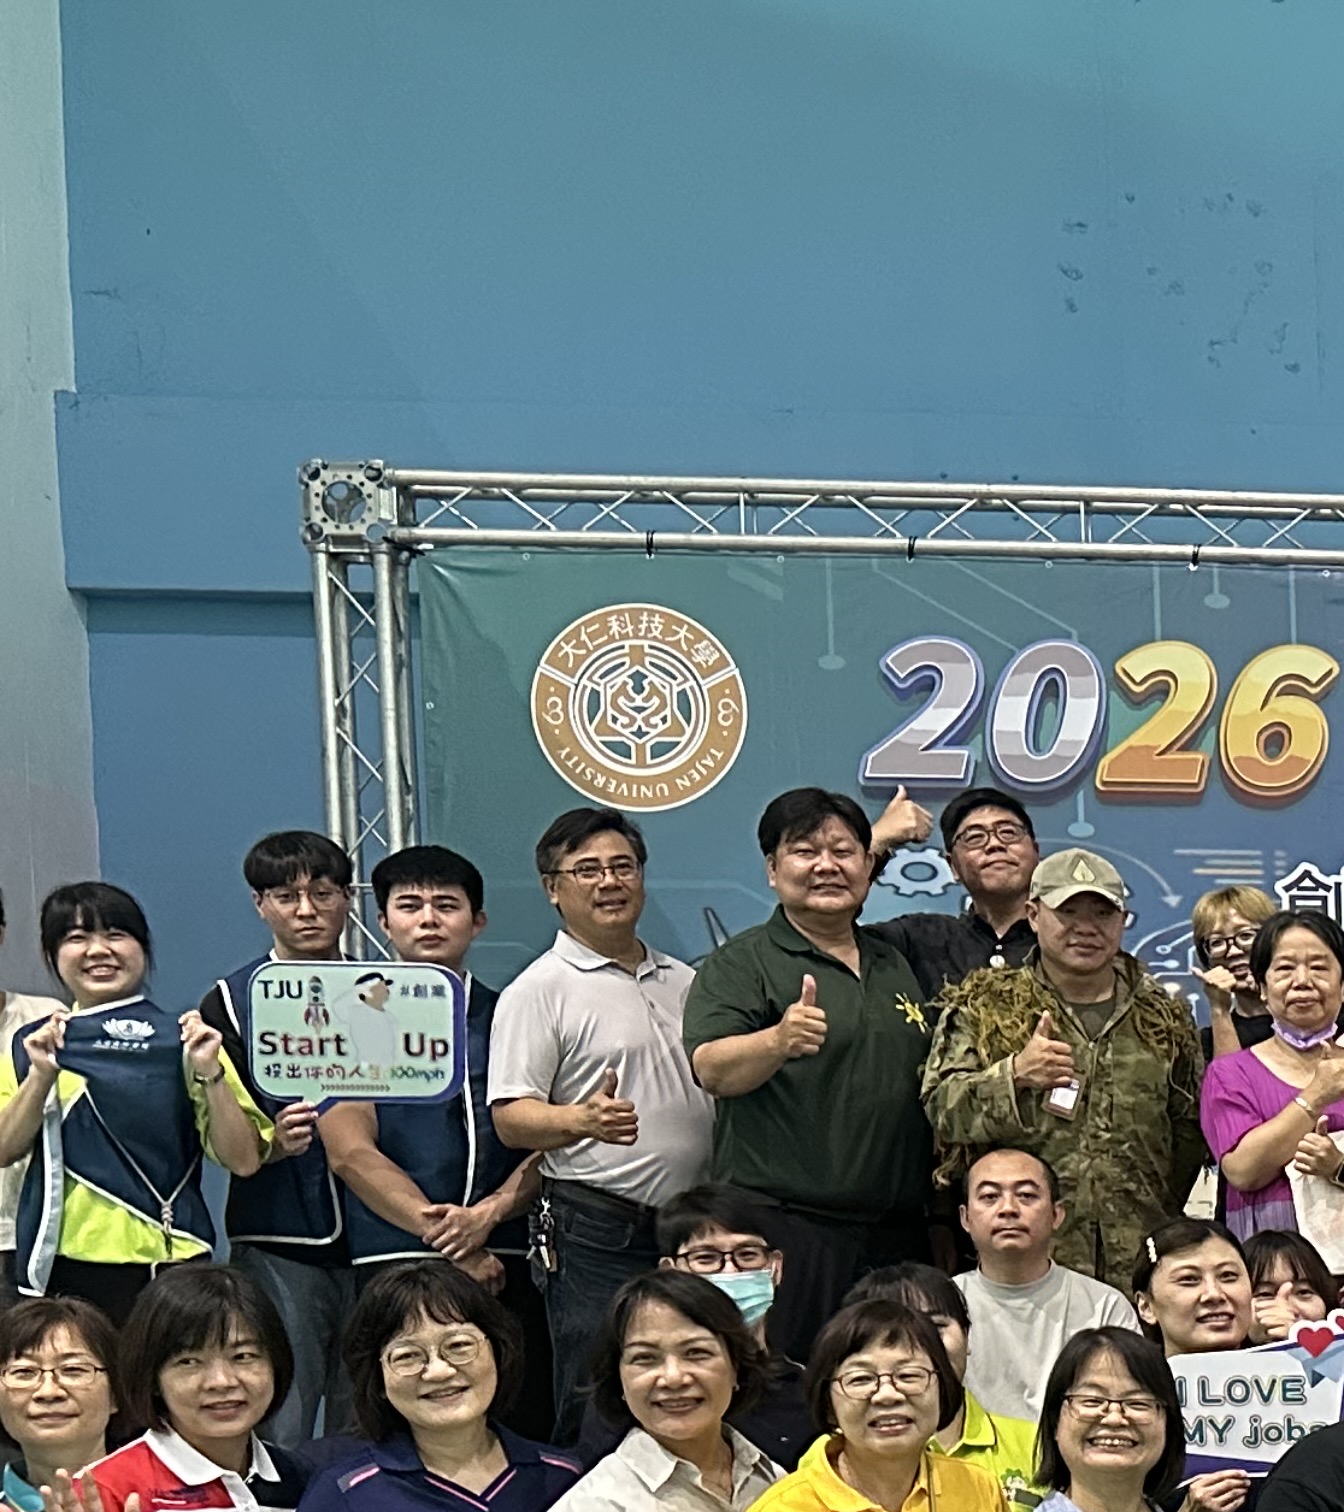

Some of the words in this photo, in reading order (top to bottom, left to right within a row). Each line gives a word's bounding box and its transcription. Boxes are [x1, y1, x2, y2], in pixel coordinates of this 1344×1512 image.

[557, 610, 721, 670] 大仁科技大學
[859, 636, 1341, 801] 2026
[556, 746, 669, 798] UNIVERSITY
[674, 747, 724, 792] TAJEN
[257, 979, 303, 1000] TJU
[258, 1030, 349, 1056] Start
[403, 1031, 449, 1060] Up
[1198, 1375, 1307, 1406] LOVE
[1183, 1415, 1235, 1447] MY
[1243, 1414, 1328, 1448] job
